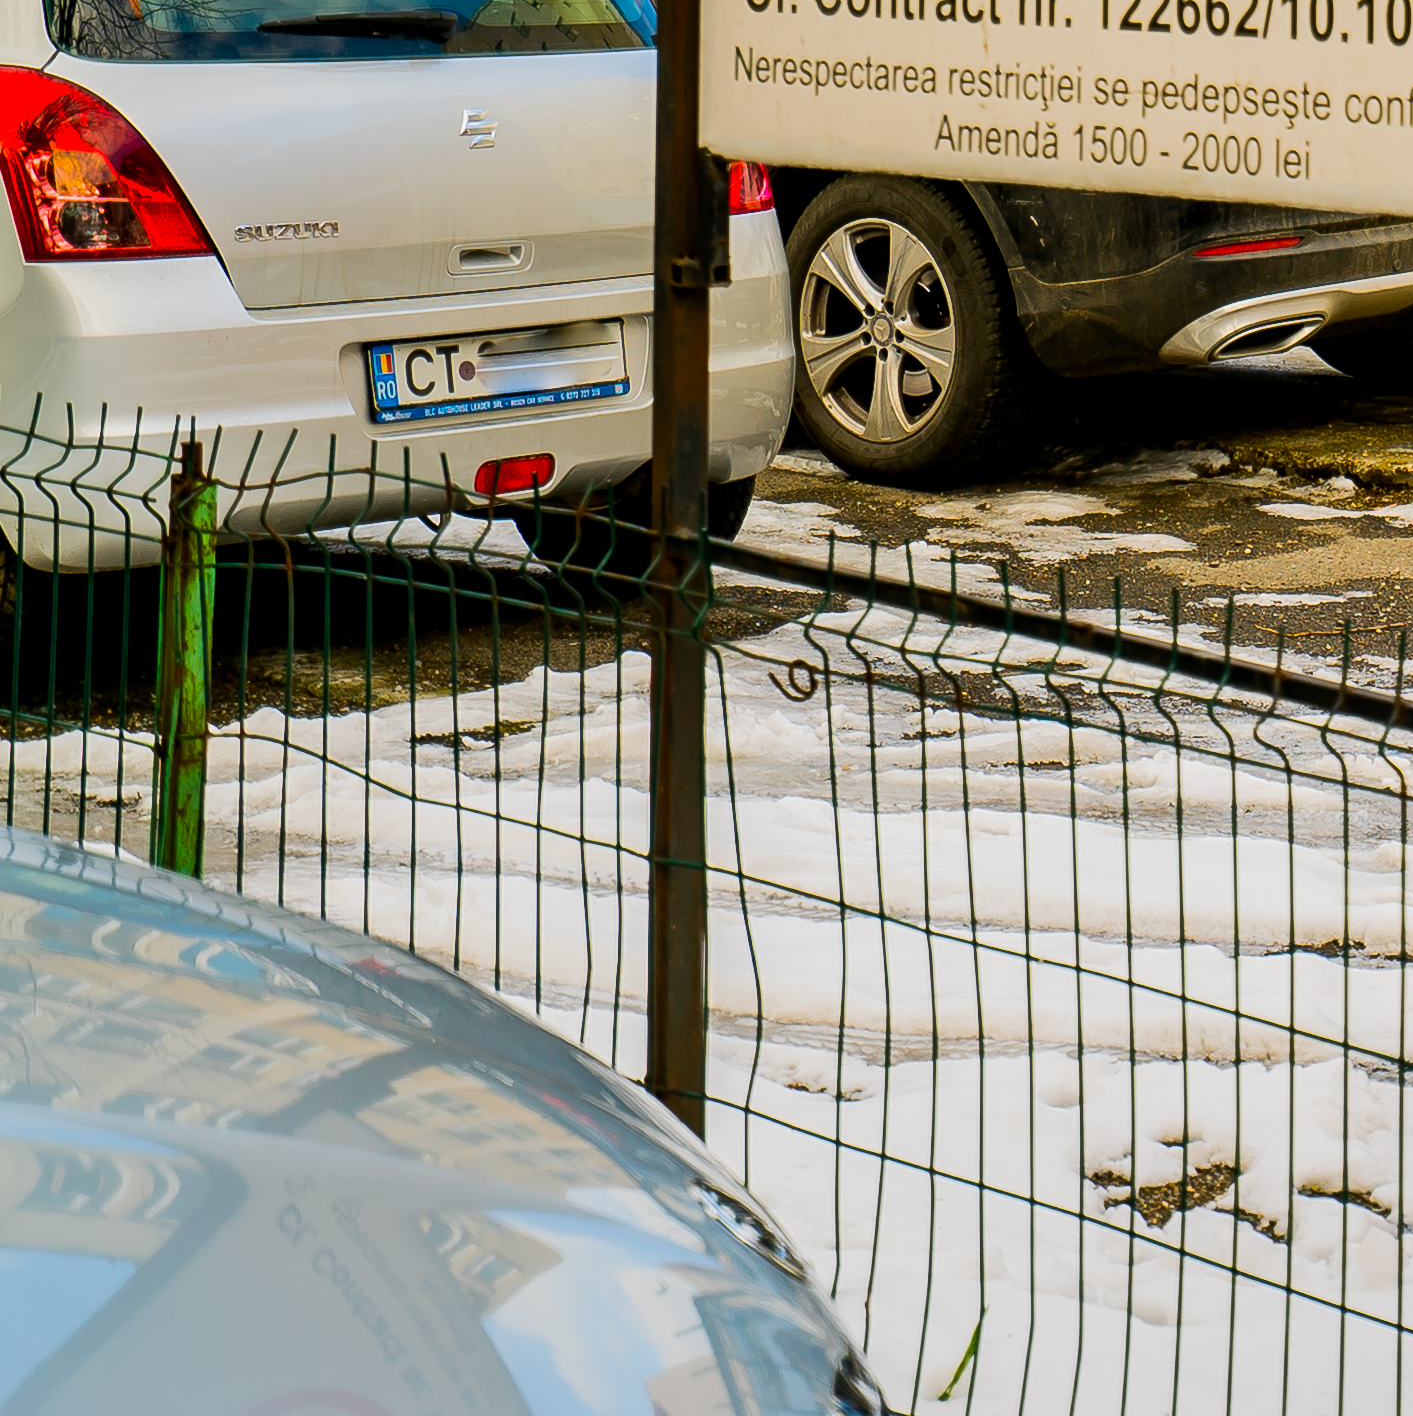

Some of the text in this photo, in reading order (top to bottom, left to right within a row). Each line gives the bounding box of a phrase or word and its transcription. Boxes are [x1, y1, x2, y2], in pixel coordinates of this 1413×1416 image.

[734, 46, 937, 96] Nerespectarea
[1093, 77, 1129, 107] se
[934, 113, 1059, 160] Amendă
[1074, 124, 1148, 167] 1500
[1182, 131, 1262, 176] 2000
[1275, 138, 1311, 180] lei
[234, 219, 340, 243] SUZUKI
[377, 343, 461, 401] RO CT
[470, 400, 491, 412] LEADER
